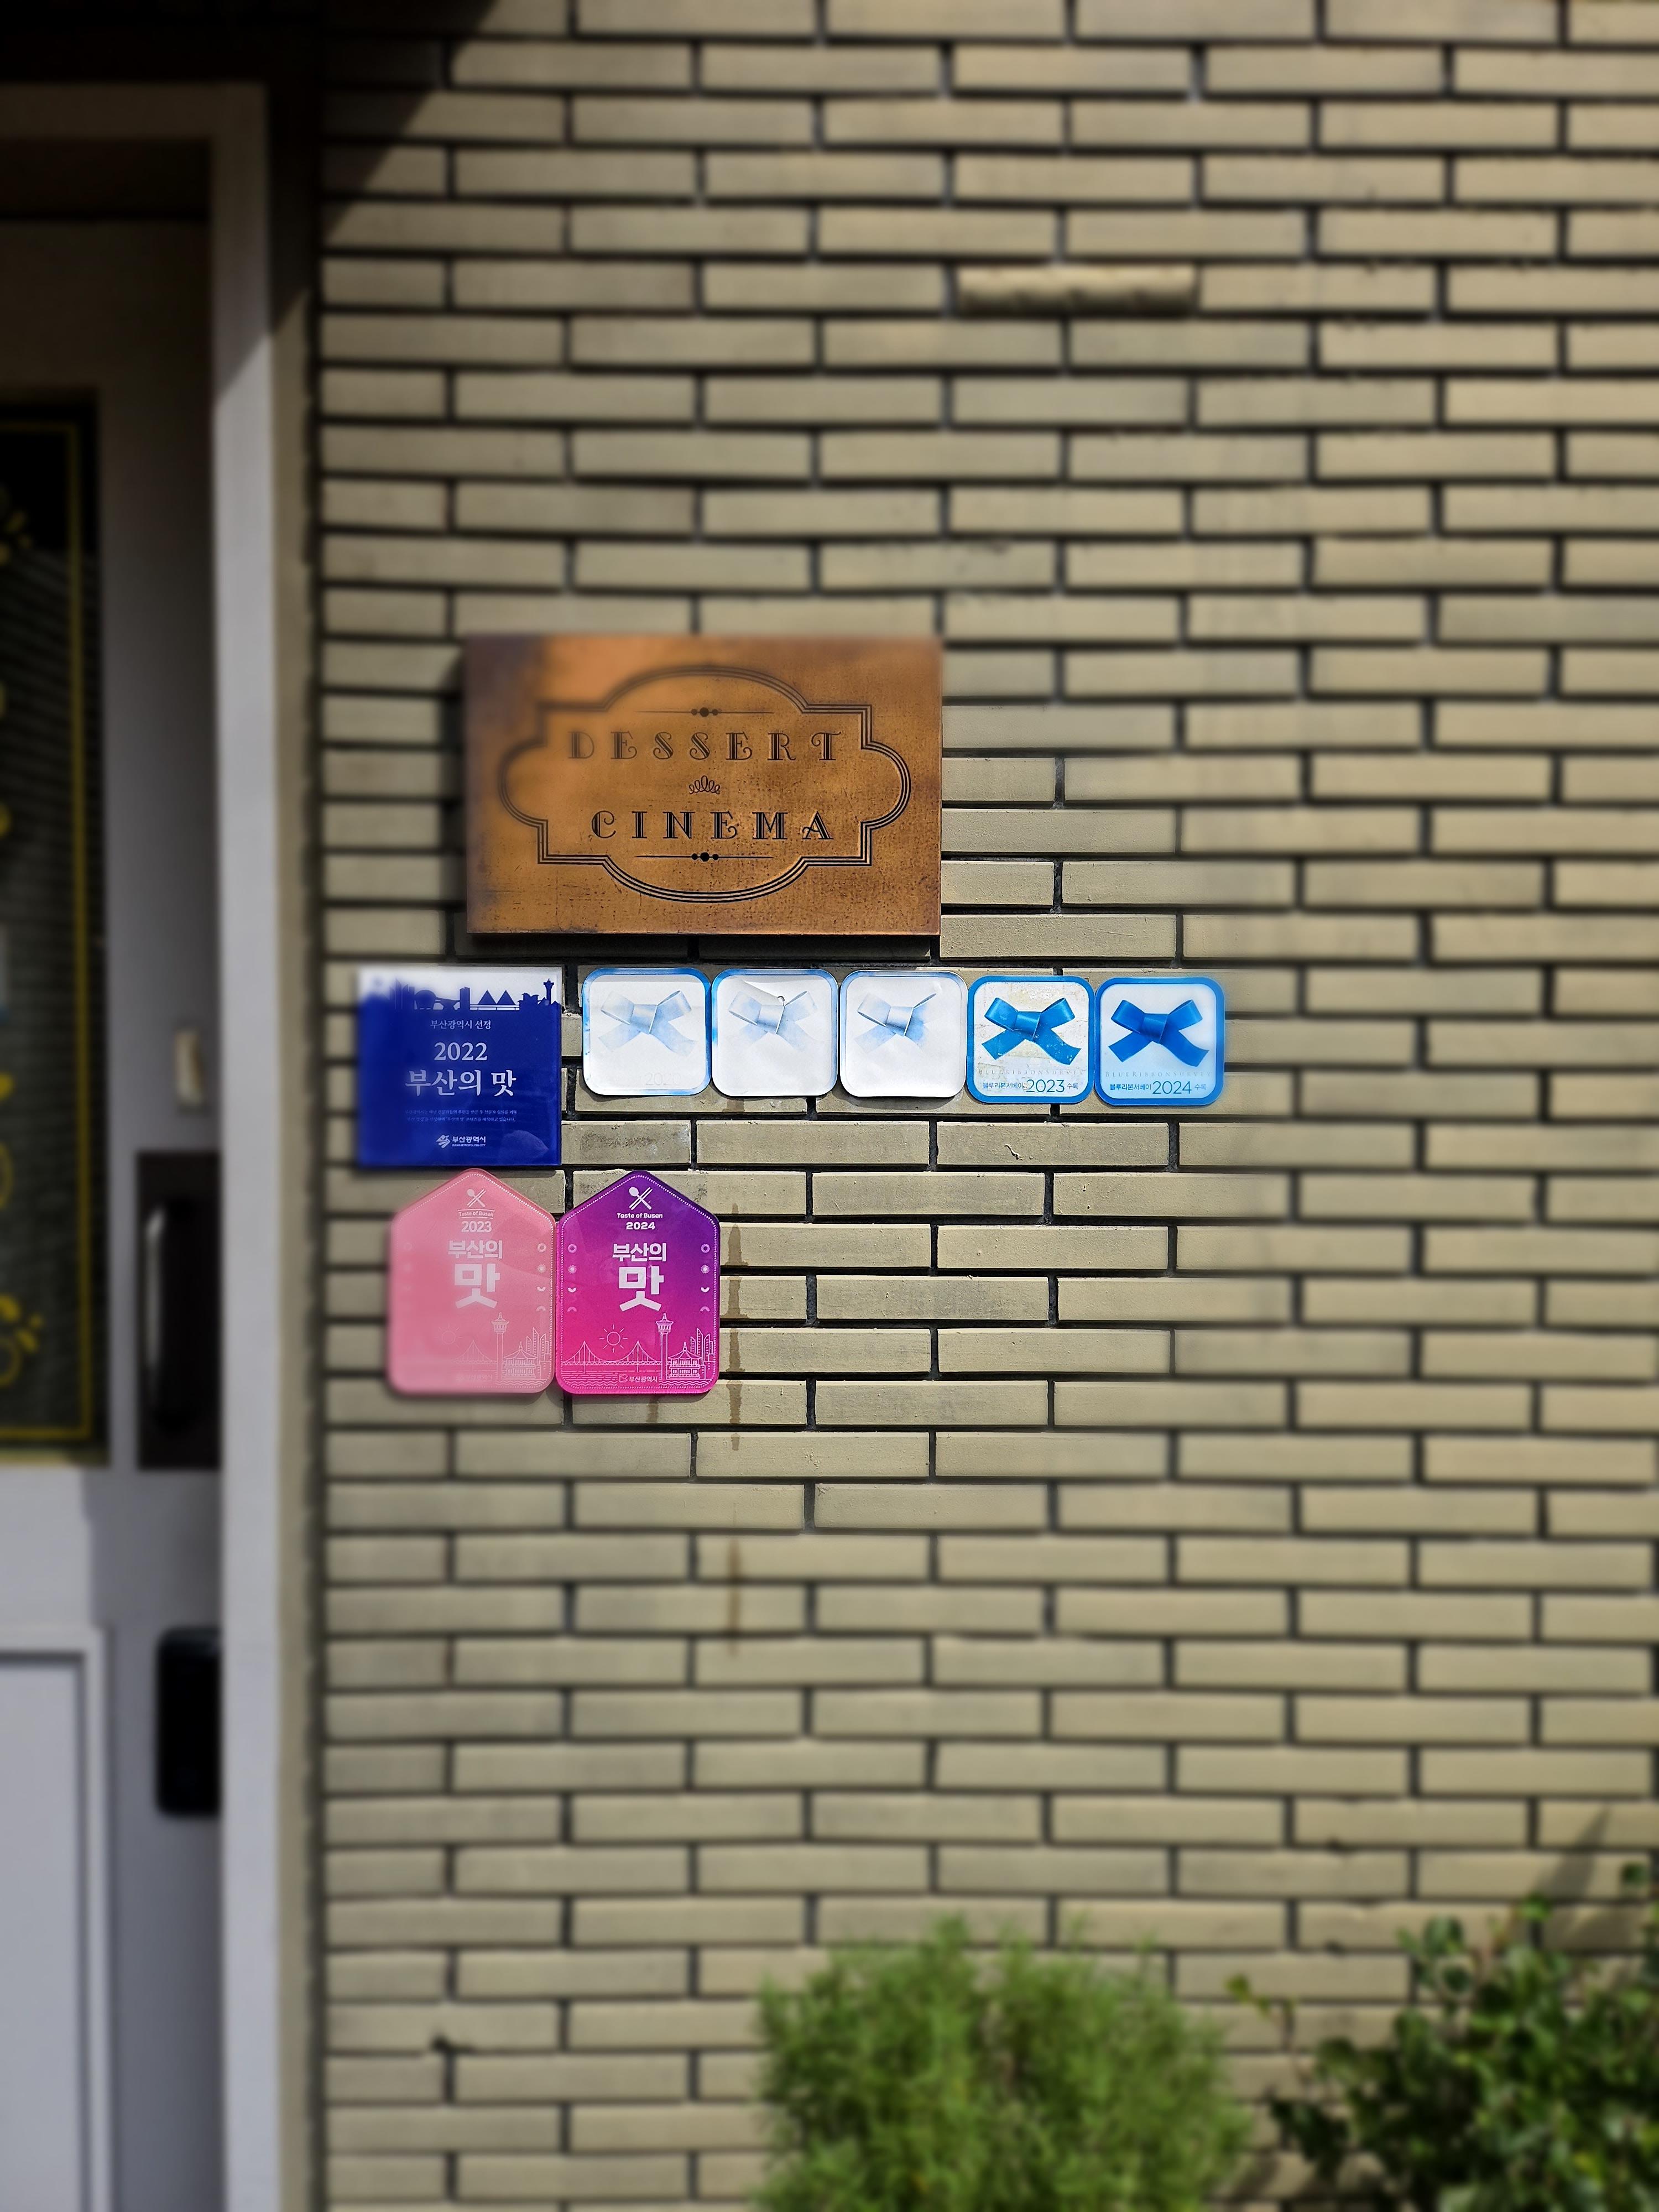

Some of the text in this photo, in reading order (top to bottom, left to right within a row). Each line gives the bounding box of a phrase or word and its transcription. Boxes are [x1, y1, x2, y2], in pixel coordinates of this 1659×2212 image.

[568, 730, 842, 761] DESSERT
[591, 810, 834, 840] CINEMA
[430, 1020, 491, 1030] 부산광역시 선정
[434, 1042, 487, 1061] 2022
[405, 1070, 517, 1097] 부산의 맛
[1025, 1079, 1065, 1093] 2023
[1152, 1081, 1192, 1094] 2024
[461, 1220, 492, 1233] 2023
[626, 1222, 656, 1230] 2024
[448, 1240, 503, 1259] 부산의
[612, 1243, 666, 1261] 부산의
[455, 1263, 500, 1309] 맛
[619, 1265, 664, 1312] 맛
